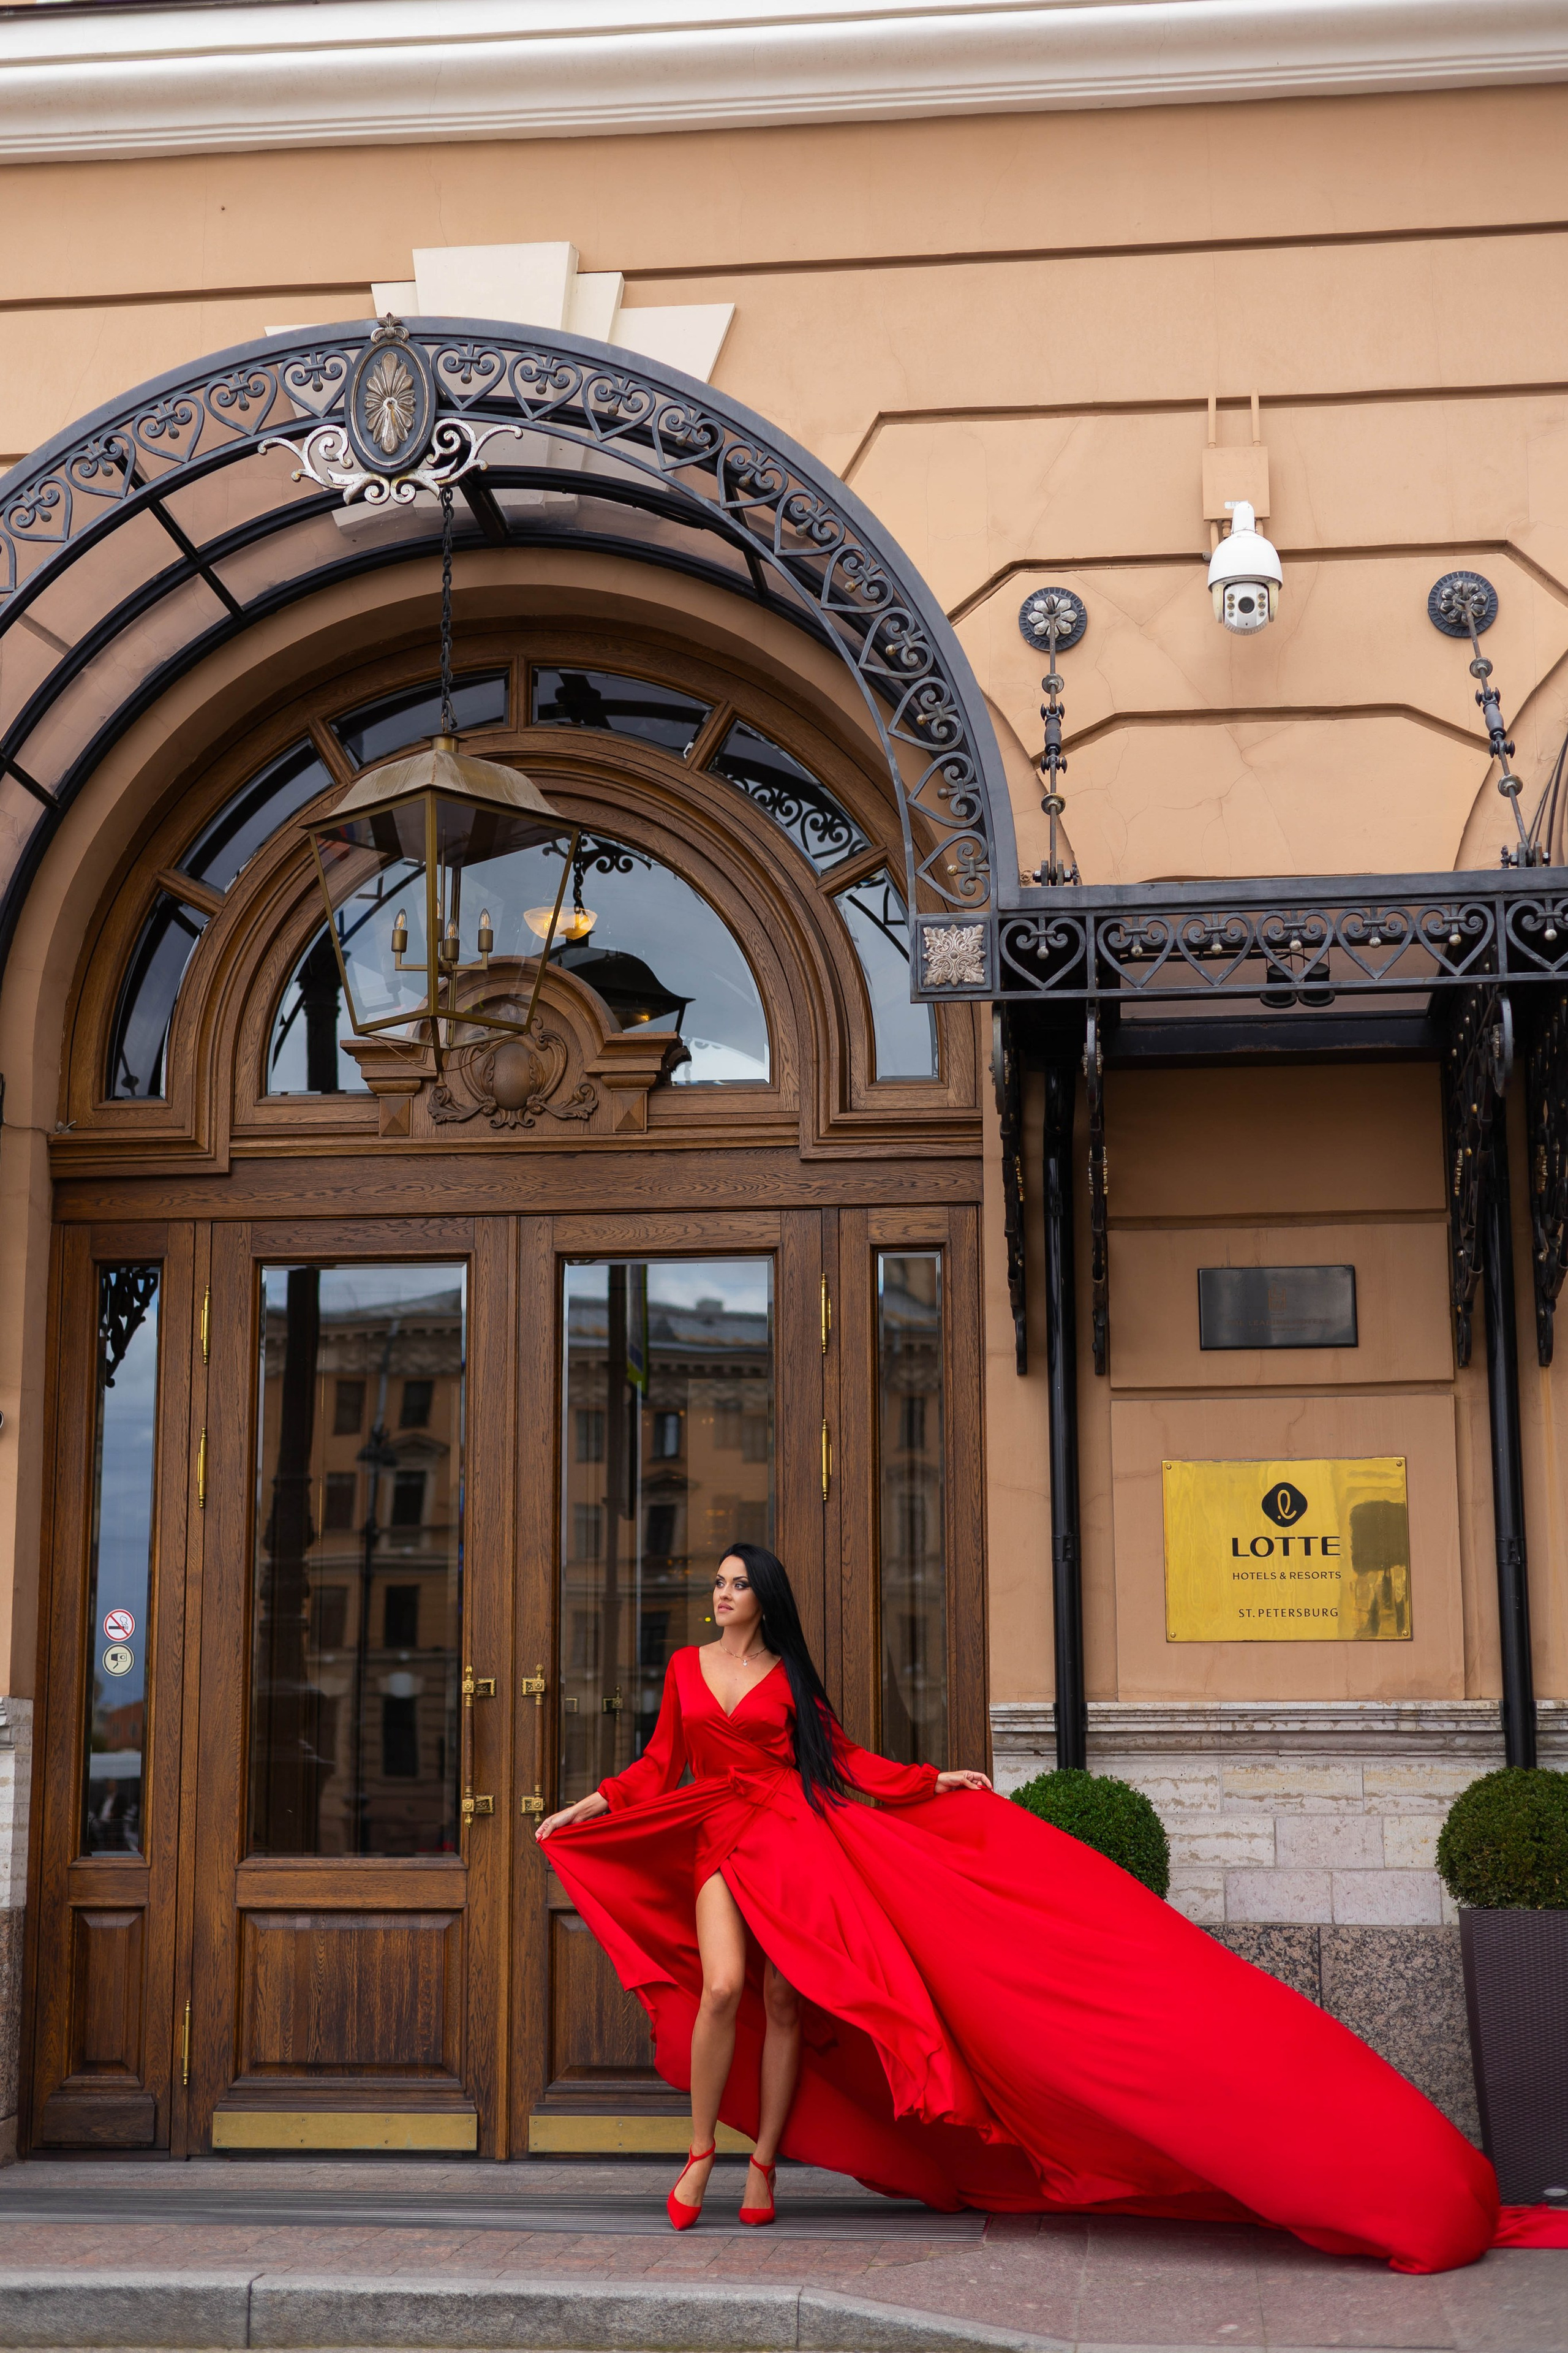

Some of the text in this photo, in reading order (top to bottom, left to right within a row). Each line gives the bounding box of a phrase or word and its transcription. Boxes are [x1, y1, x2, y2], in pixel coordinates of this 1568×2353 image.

[1232, 1536, 1341, 1557] LOTTE
[1280, 1571, 1286, 1580] &
[1289, 1571, 1341, 1580] RESORTS
[1238, 1608, 1338, 1618] ST. PETERSBURG
